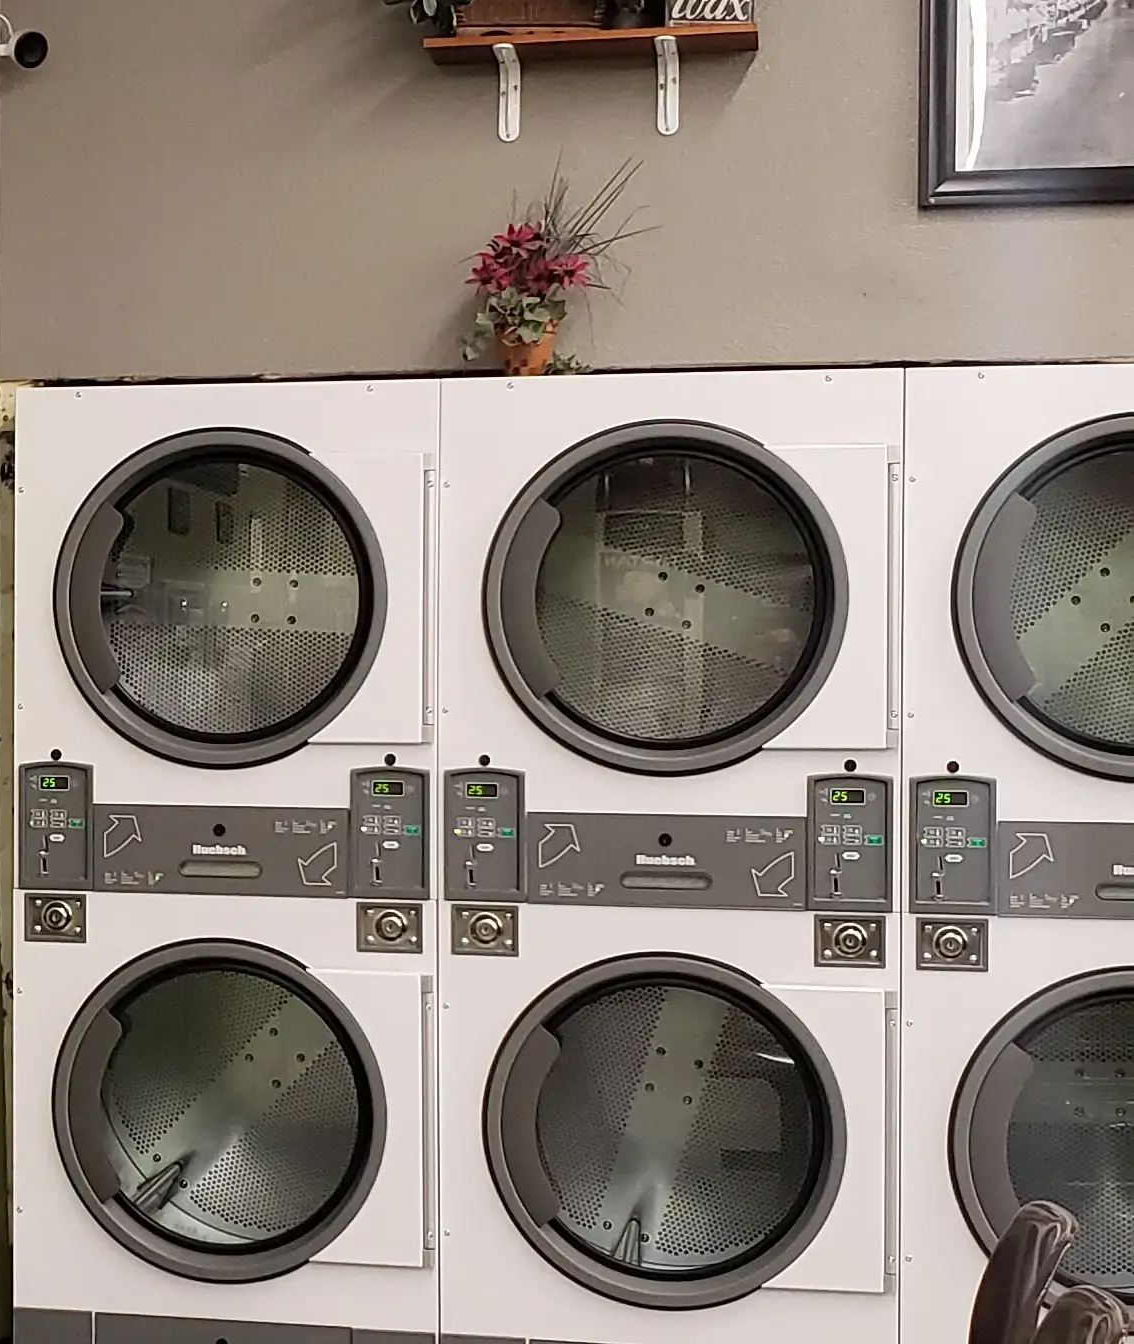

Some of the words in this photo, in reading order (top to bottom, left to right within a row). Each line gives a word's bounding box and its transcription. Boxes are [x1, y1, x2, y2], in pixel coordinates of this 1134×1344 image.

[42, 777, 56, 787] 25
[375, 784, 389, 793] 25
[468, 785, 483, 795] 25
[832, 791, 848, 801] 25
[936, 793, 951, 803] 25
